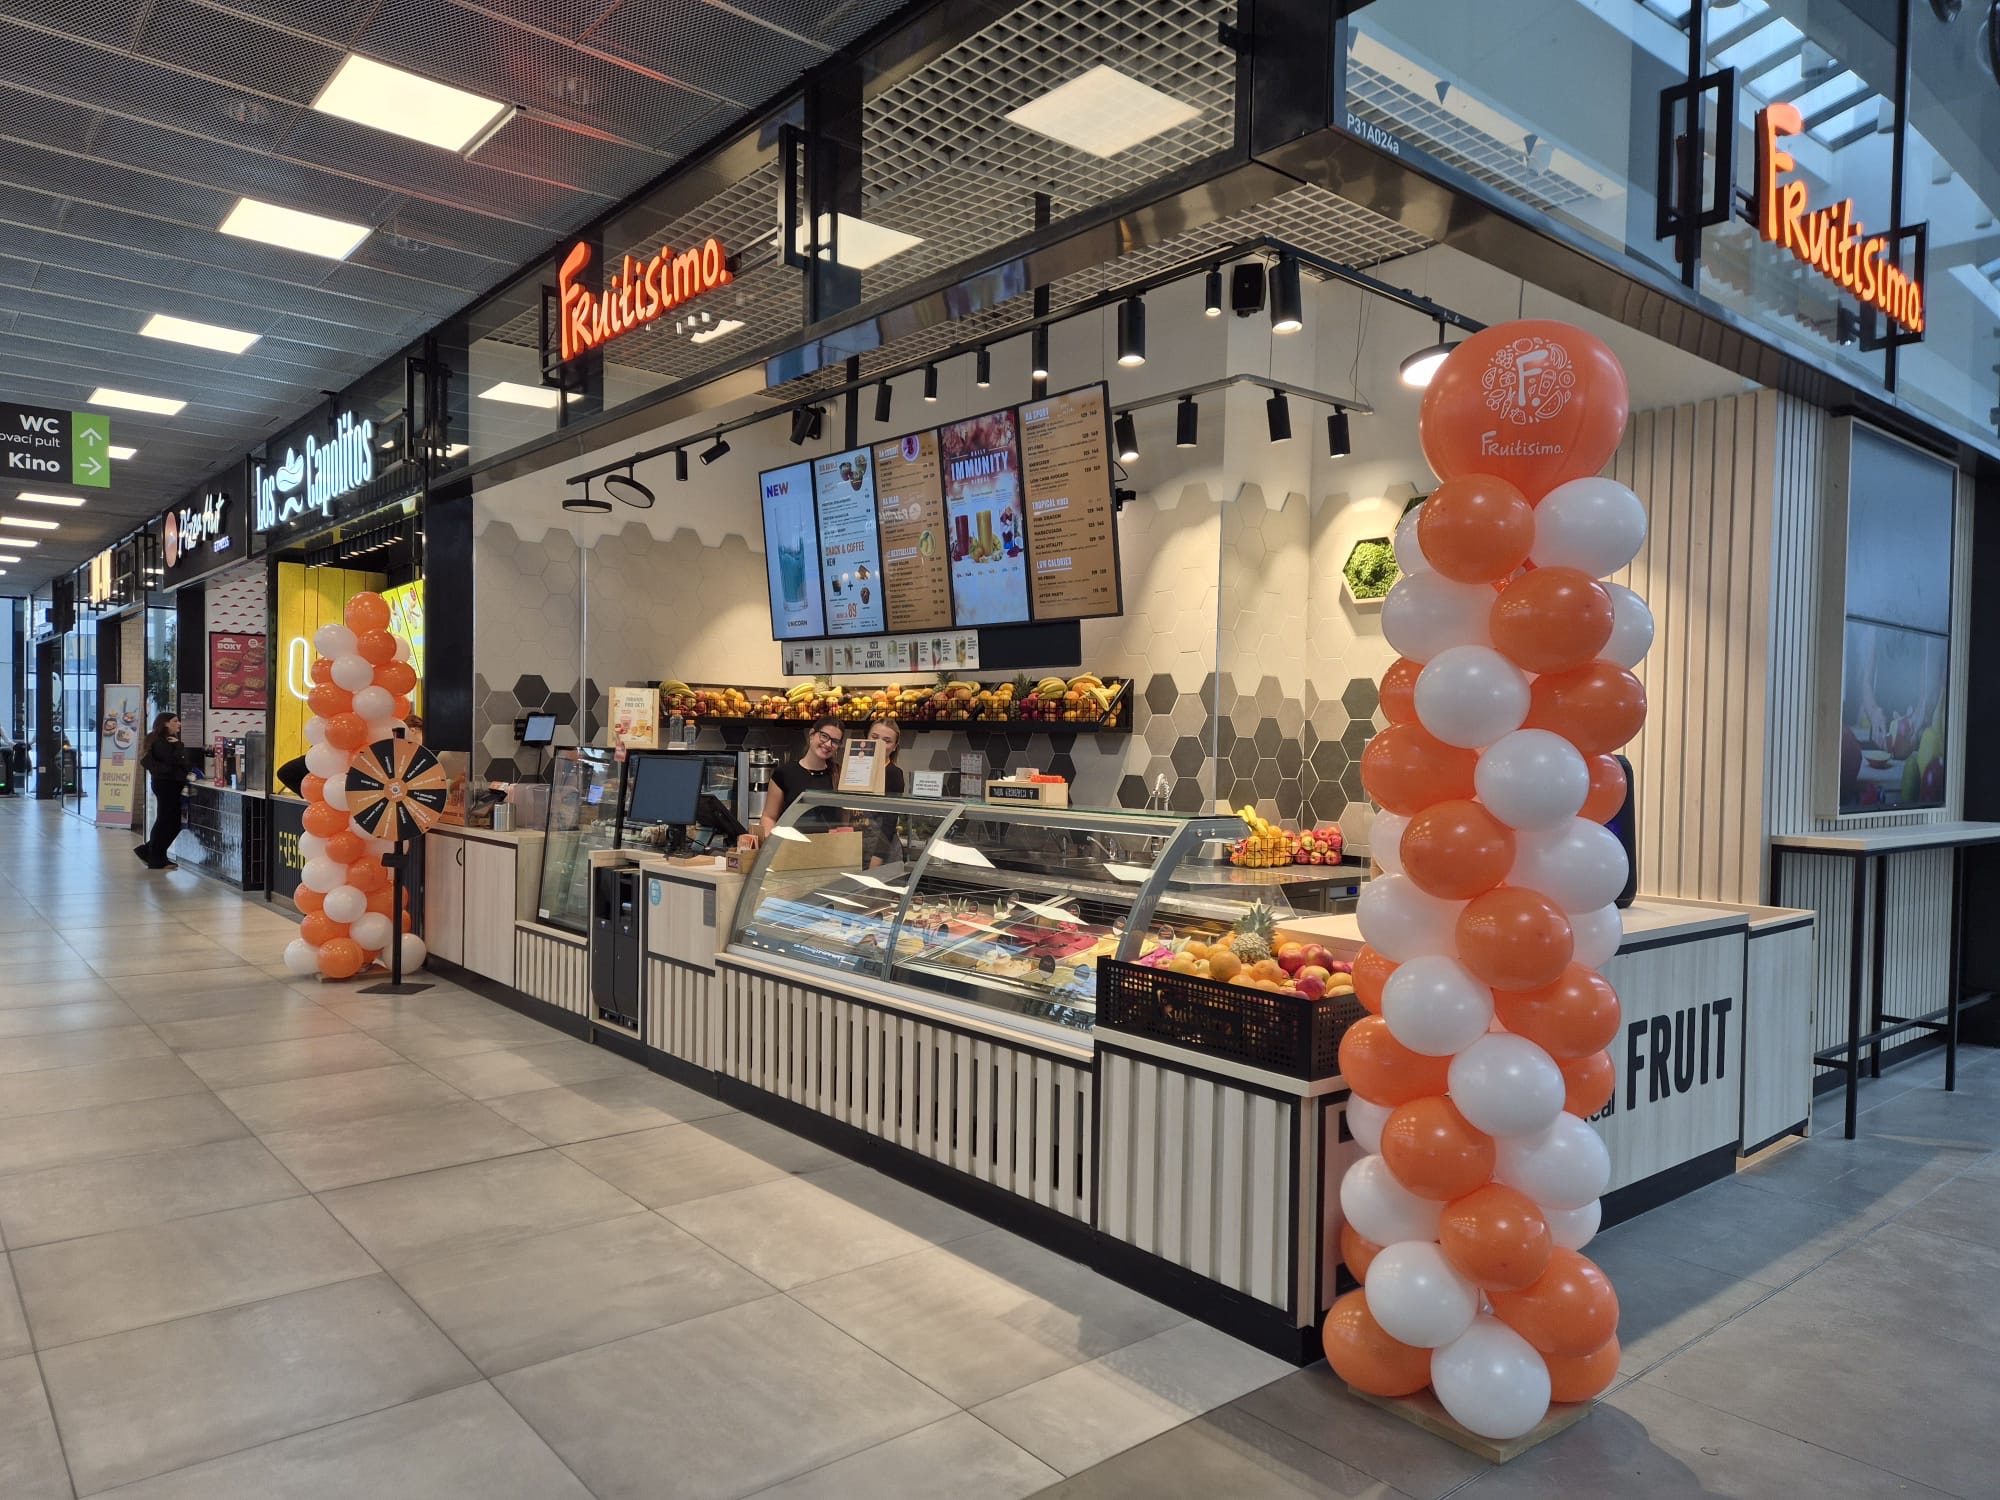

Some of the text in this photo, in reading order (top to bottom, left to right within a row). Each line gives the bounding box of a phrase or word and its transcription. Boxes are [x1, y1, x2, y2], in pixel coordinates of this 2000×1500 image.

[1347, 112, 1400, 155] P31A024a
[19, 414, 60, 434] WC
[35, 436, 61, 448] pult
[8, 451, 61, 472] Kino
[256, 409, 373, 531] Los Capolitos
[951, 450, 1008, 481] IMMUNITY
[766, 481, 789, 498] NEW
[178, 491, 225, 558] Pizza Hut
[846, 541, 865, 553] COFFEE
[788, 620, 808, 628] UNICORN
[867, 650, 881, 659] COFFEE
[869, 660, 885, 668] MATCHA
[1626, 997, 1733, 1112] FRUIT
